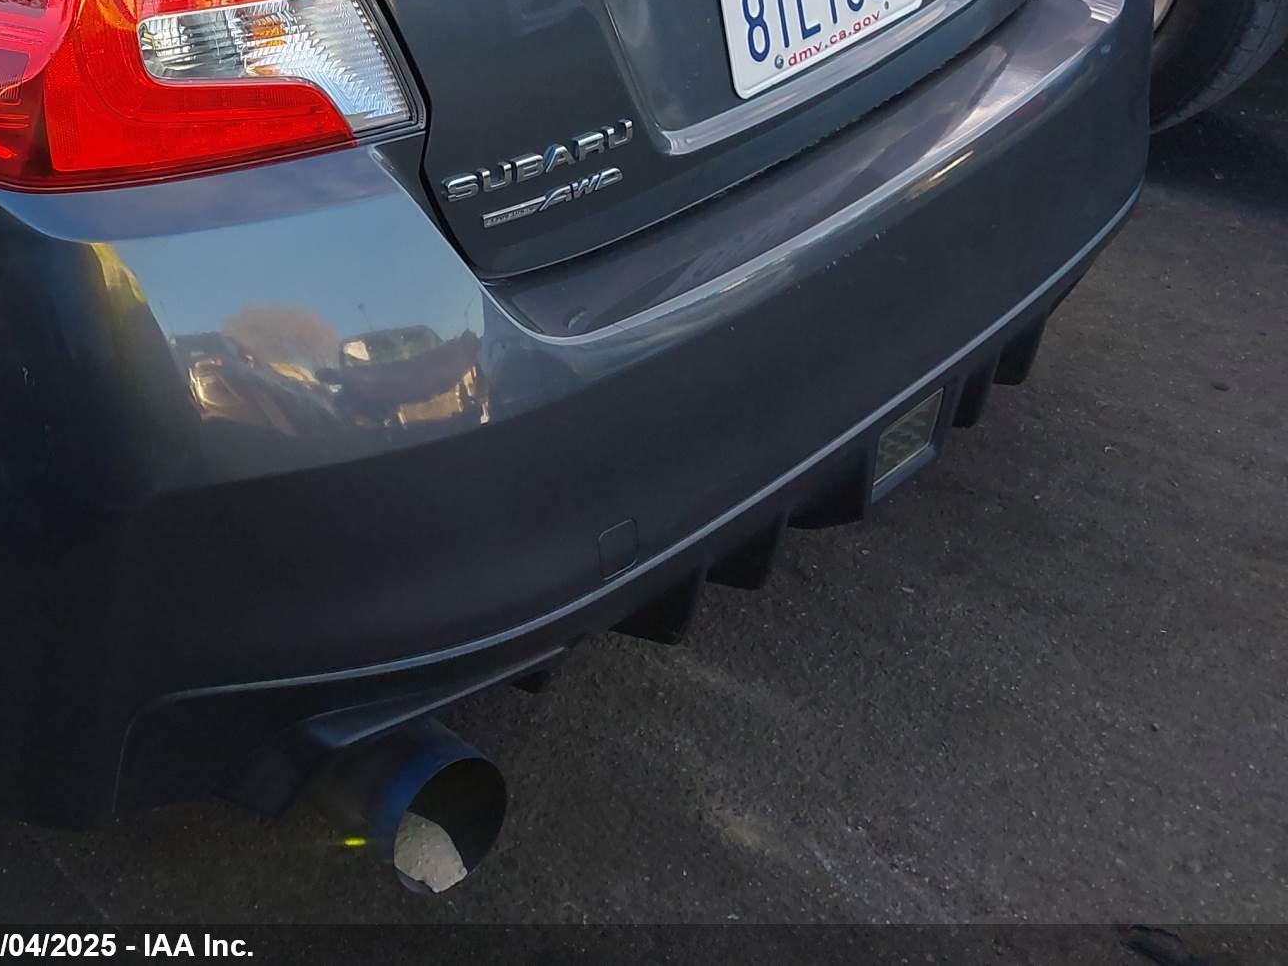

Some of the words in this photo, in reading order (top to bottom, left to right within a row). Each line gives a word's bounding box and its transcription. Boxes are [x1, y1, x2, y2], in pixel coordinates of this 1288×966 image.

[787, 10, 881, 68] dmv.ca.gov
[443, 118, 633, 202] SUBARU
[538, 167, 624, 212] AWD
